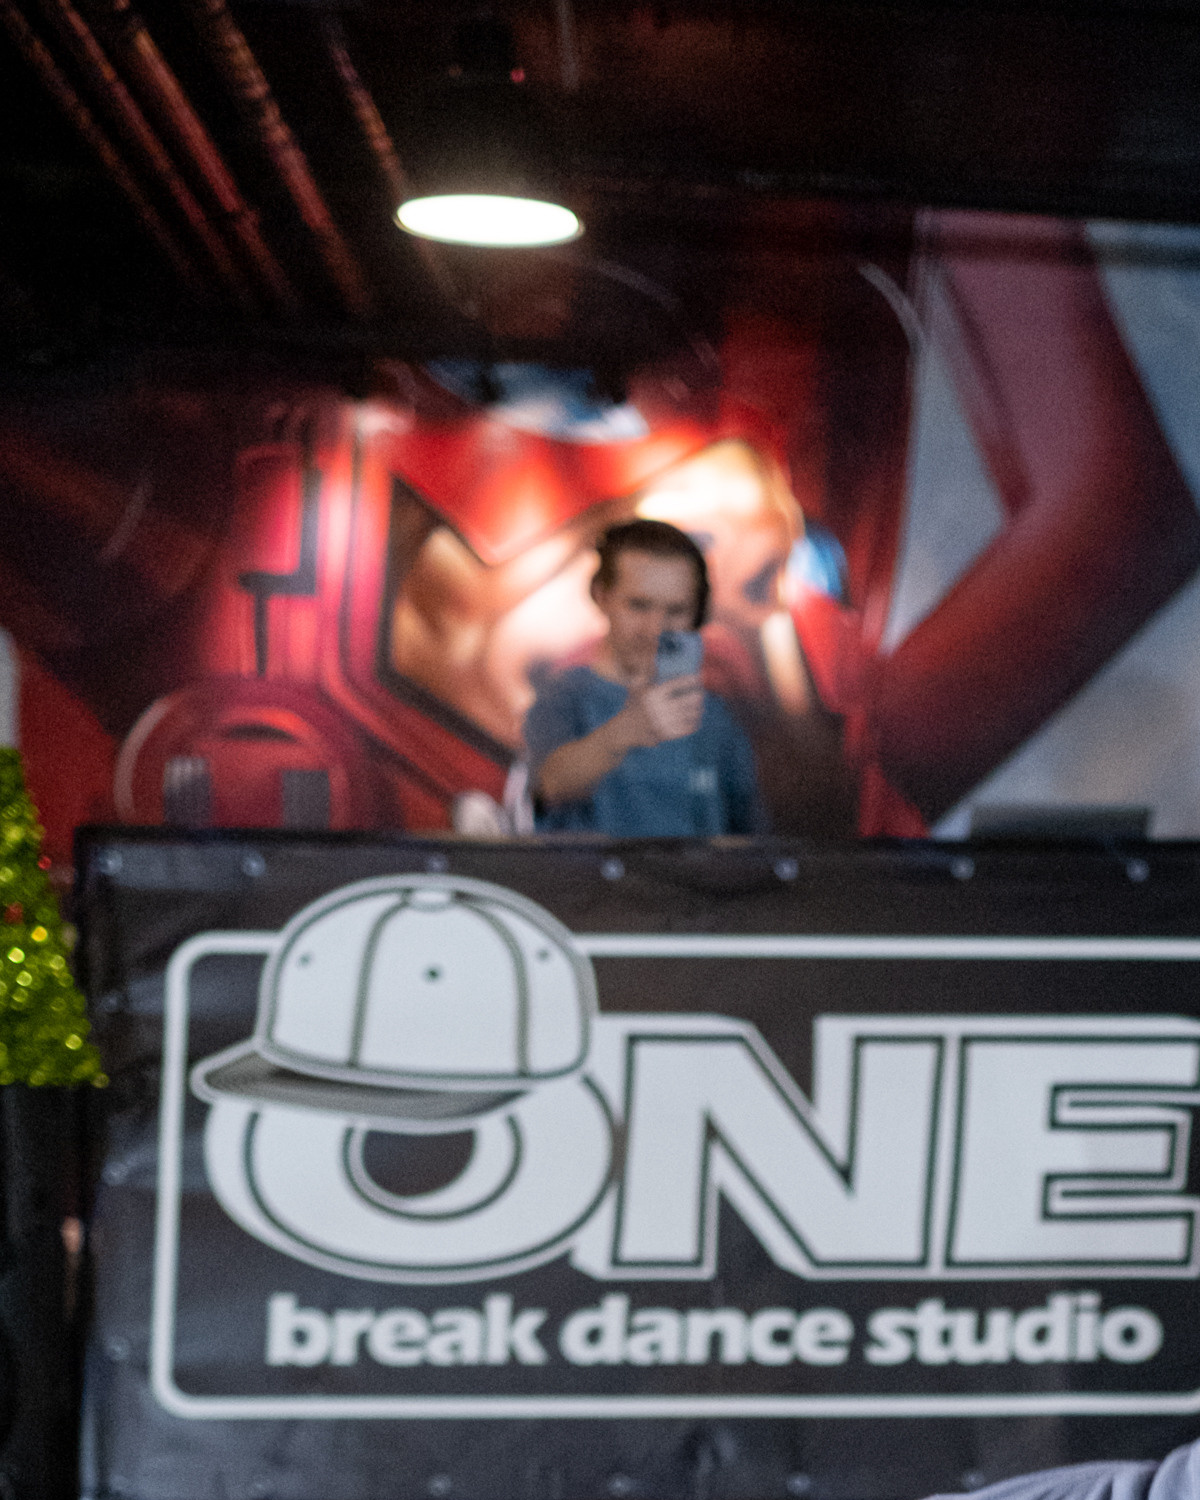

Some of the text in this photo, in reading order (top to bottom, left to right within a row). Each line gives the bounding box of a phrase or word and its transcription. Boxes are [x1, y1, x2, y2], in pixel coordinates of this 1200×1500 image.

[265, 1291, 1163, 1366] break dance studio
